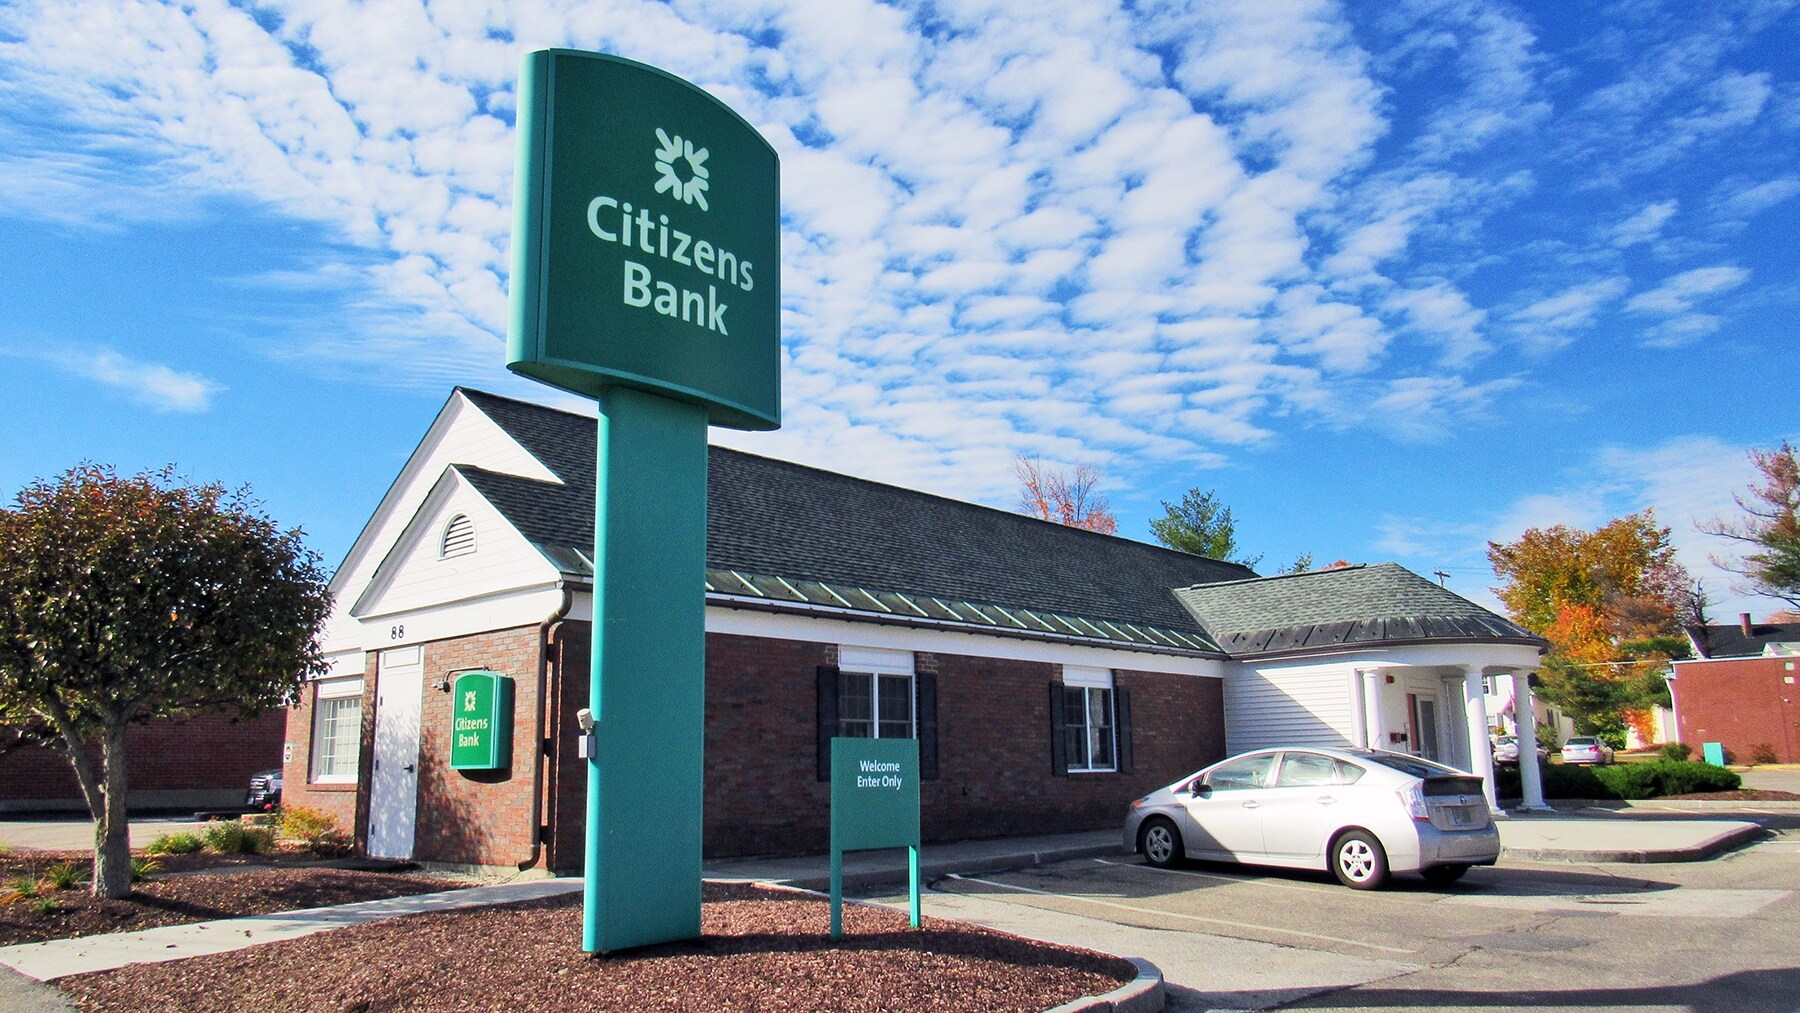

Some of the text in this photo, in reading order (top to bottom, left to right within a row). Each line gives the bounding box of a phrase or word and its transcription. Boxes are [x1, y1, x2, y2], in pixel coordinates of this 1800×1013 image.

[587, 196, 753, 292] Citizens
[623, 260, 729, 336] Bank
[391, 625, 404, 639] 88
[455, 717, 488, 731] Citizens
[458, 732, 479, 747] Bank
[860, 760, 900, 772] Welcome
[857, 775, 902, 790] Enter Only
